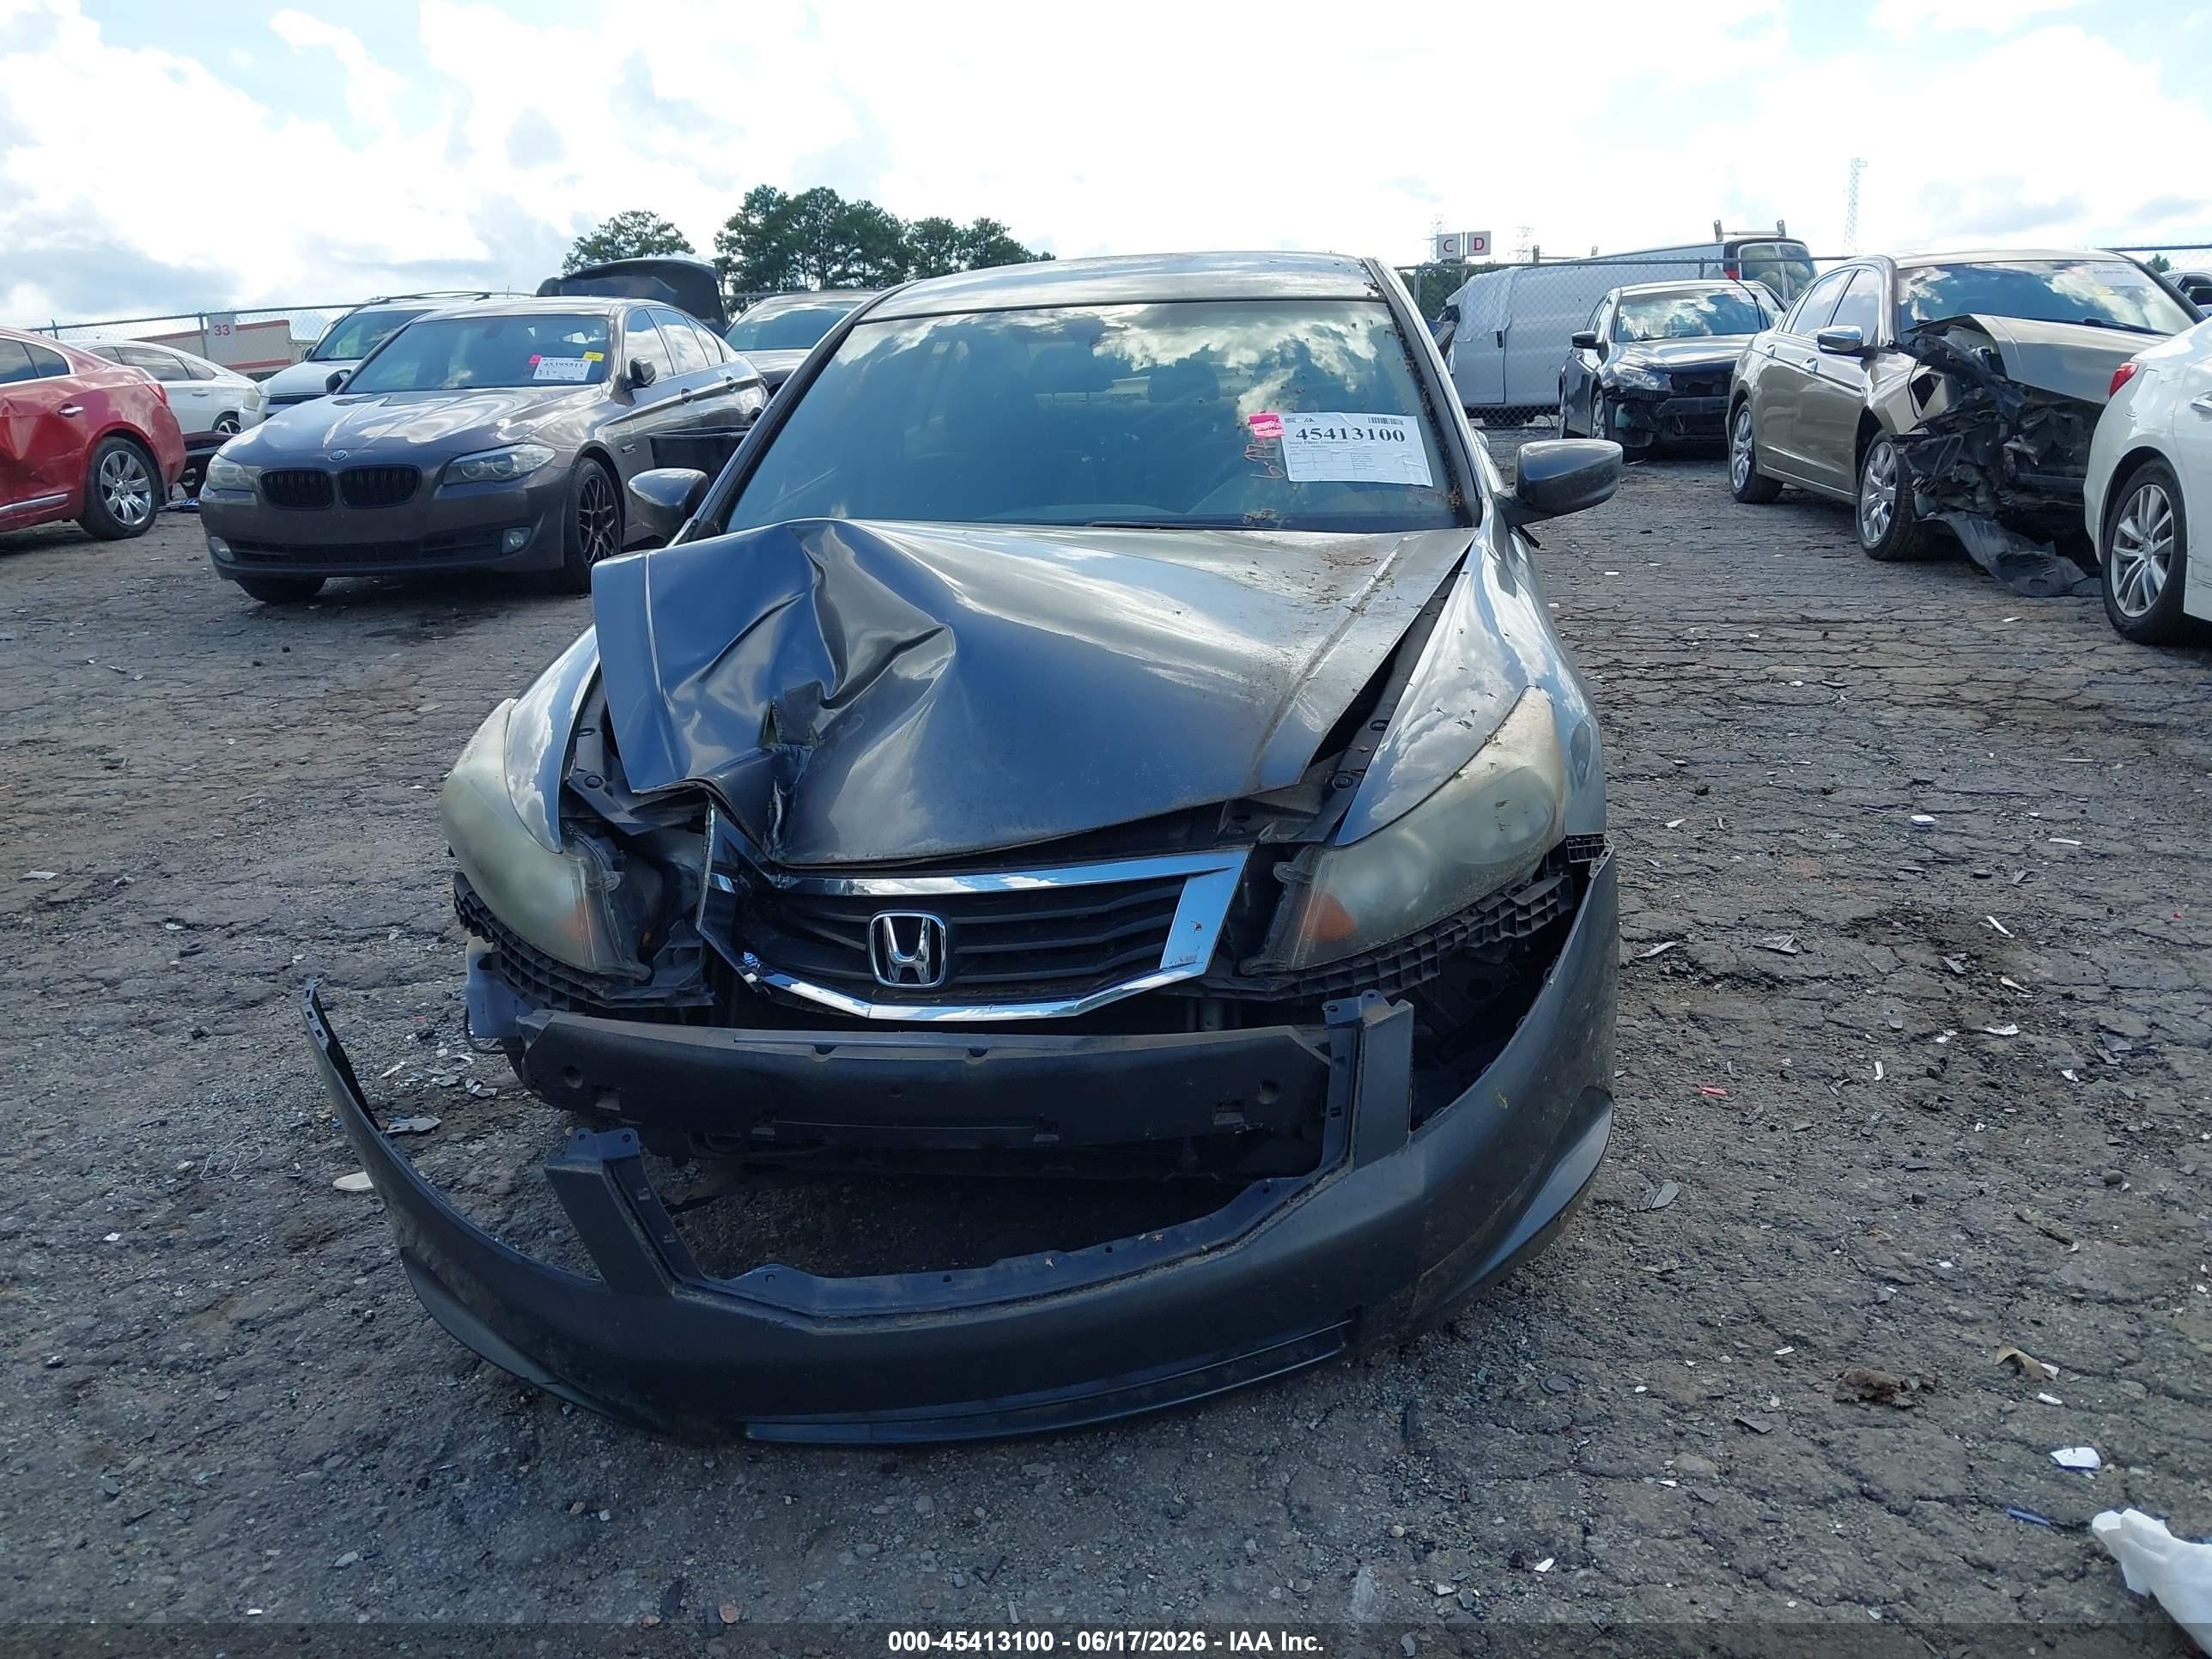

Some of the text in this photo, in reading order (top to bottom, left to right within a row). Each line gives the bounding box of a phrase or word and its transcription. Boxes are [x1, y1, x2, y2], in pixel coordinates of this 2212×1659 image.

[1443, 239, 1454, 252] C
[1474, 237, 1485, 251] D
[214, 324, 230, 336] 33
[1295, 428, 1406, 443] 45413100
